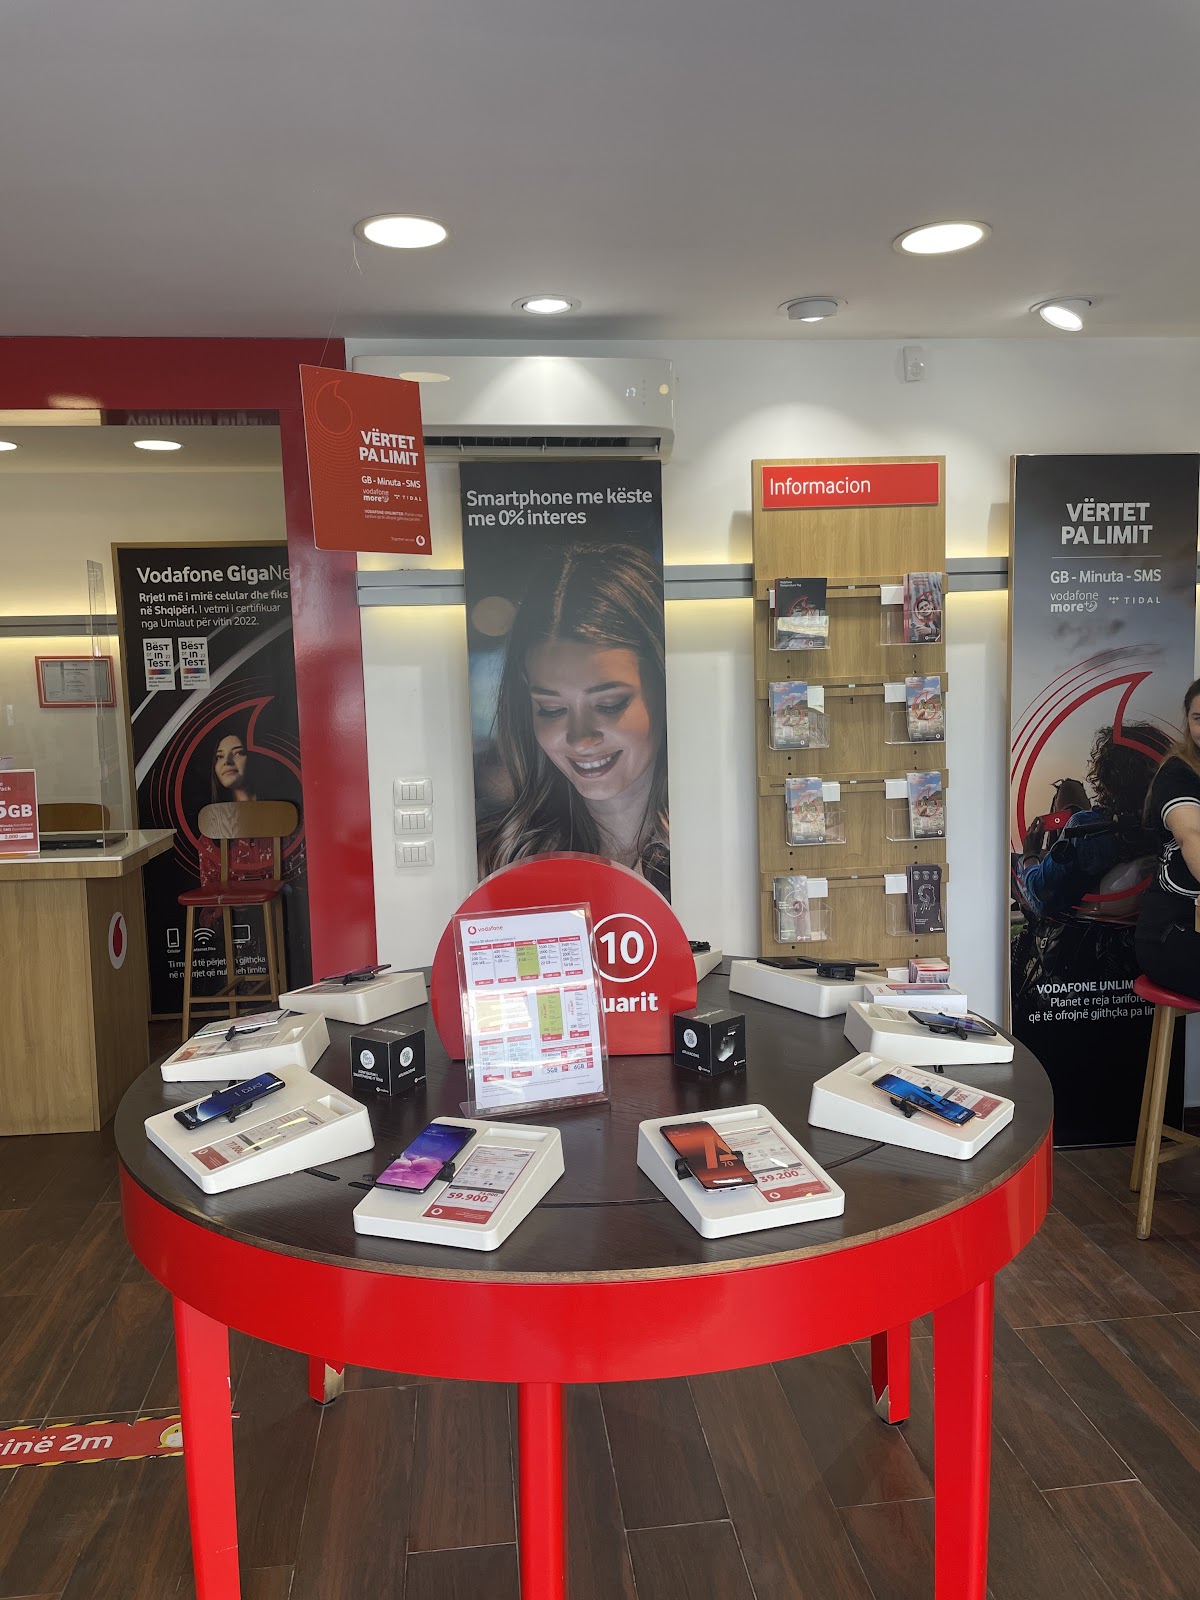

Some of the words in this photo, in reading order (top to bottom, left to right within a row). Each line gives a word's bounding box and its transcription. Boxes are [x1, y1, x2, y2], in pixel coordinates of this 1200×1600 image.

[360, 428, 416, 450] VËRTET
[359, 447, 379, 462] PA
[380, 449, 419, 466] LIMIT
[361, 475, 372, 484] GB
[377, 476, 401, 487] Minuta
[405, 479, 421, 489] SMS
[770, 477, 871, 496] Informacion
[362, 488, 390, 496] vodafone
[466, 489, 573, 509] Smartphone
[576, 491, 604, 505] me
[606, 487, 653, 504] këste
[1066, 497, 1151, 522] VËRTET
[468, 512, 496, 527] me
[499, 509, 524, 526] 0%
[527, 509, 587, 525] interes
[1061, 525, 1090, 545] PA
[1093, 525, 1153, 544] LIMIT
[136, 566, 224, 584] Vodafone
[227, 564, 291, 585] GigaNe
[1050, 570, 1069, 584] GB
[1079, 570, 1124, 583] Minuta
[1133, 569, 1162, 582] SMS
[139, 592, 166, 604] Rrjeti
[167, 591, 184, 602] më
[190, 591, 213, 601] mirë
[214, 591, 249, 601] celular
[250, 590, 269, 600] dhe
[270, 590, 289, 599] fiks
[1050, 590, 1099, 601] vodafone
[1124, 596, 1161, 604] TIDAL
[140, 606, 153, 616] në
[154, 605, 198, 617] Shqipëri.
[203, 604, 230, 613] vetmi
[236, 603, 281, 613] certifikuar
[141, 620, 159, 631] nga
[160, 618, 195, 628] Umlaut
[196, 617, 211, 629] për
[212, 617, 233, 626] vitin
[234, 616, 260, 626] 2022.
[599, 930, 645, 965] 10
[167, 960, 175, 968] Ti
[1036, 982, 1097, 995] VODAFONE
[1099, 979, 1134, 991] UNLIM
[602, 991, 659, 1013] uarit
[1050, 996, 1082, 1008] Planet
[1083, 997, 1090, 1006] e
[1092, 995, 1110, 1007] reja
[1028, 1011, 1041, 1024] që
[1043, 1010, 1053, 1021] të
[1055, 1008, 1089, 1022] ofrojnë
[1091, 1007, 1129, 1021] gjithçka
[1130, 1008, 1143, 1019] pa
[720, 1160, 735, 1168] 70
[759, 1170, 800, 1183] 39.200
[446, 1192, 489, 1203] 59.900
[0, 1435, 57, 1456] inë
[58, 1433, 115, 1452] 2m
